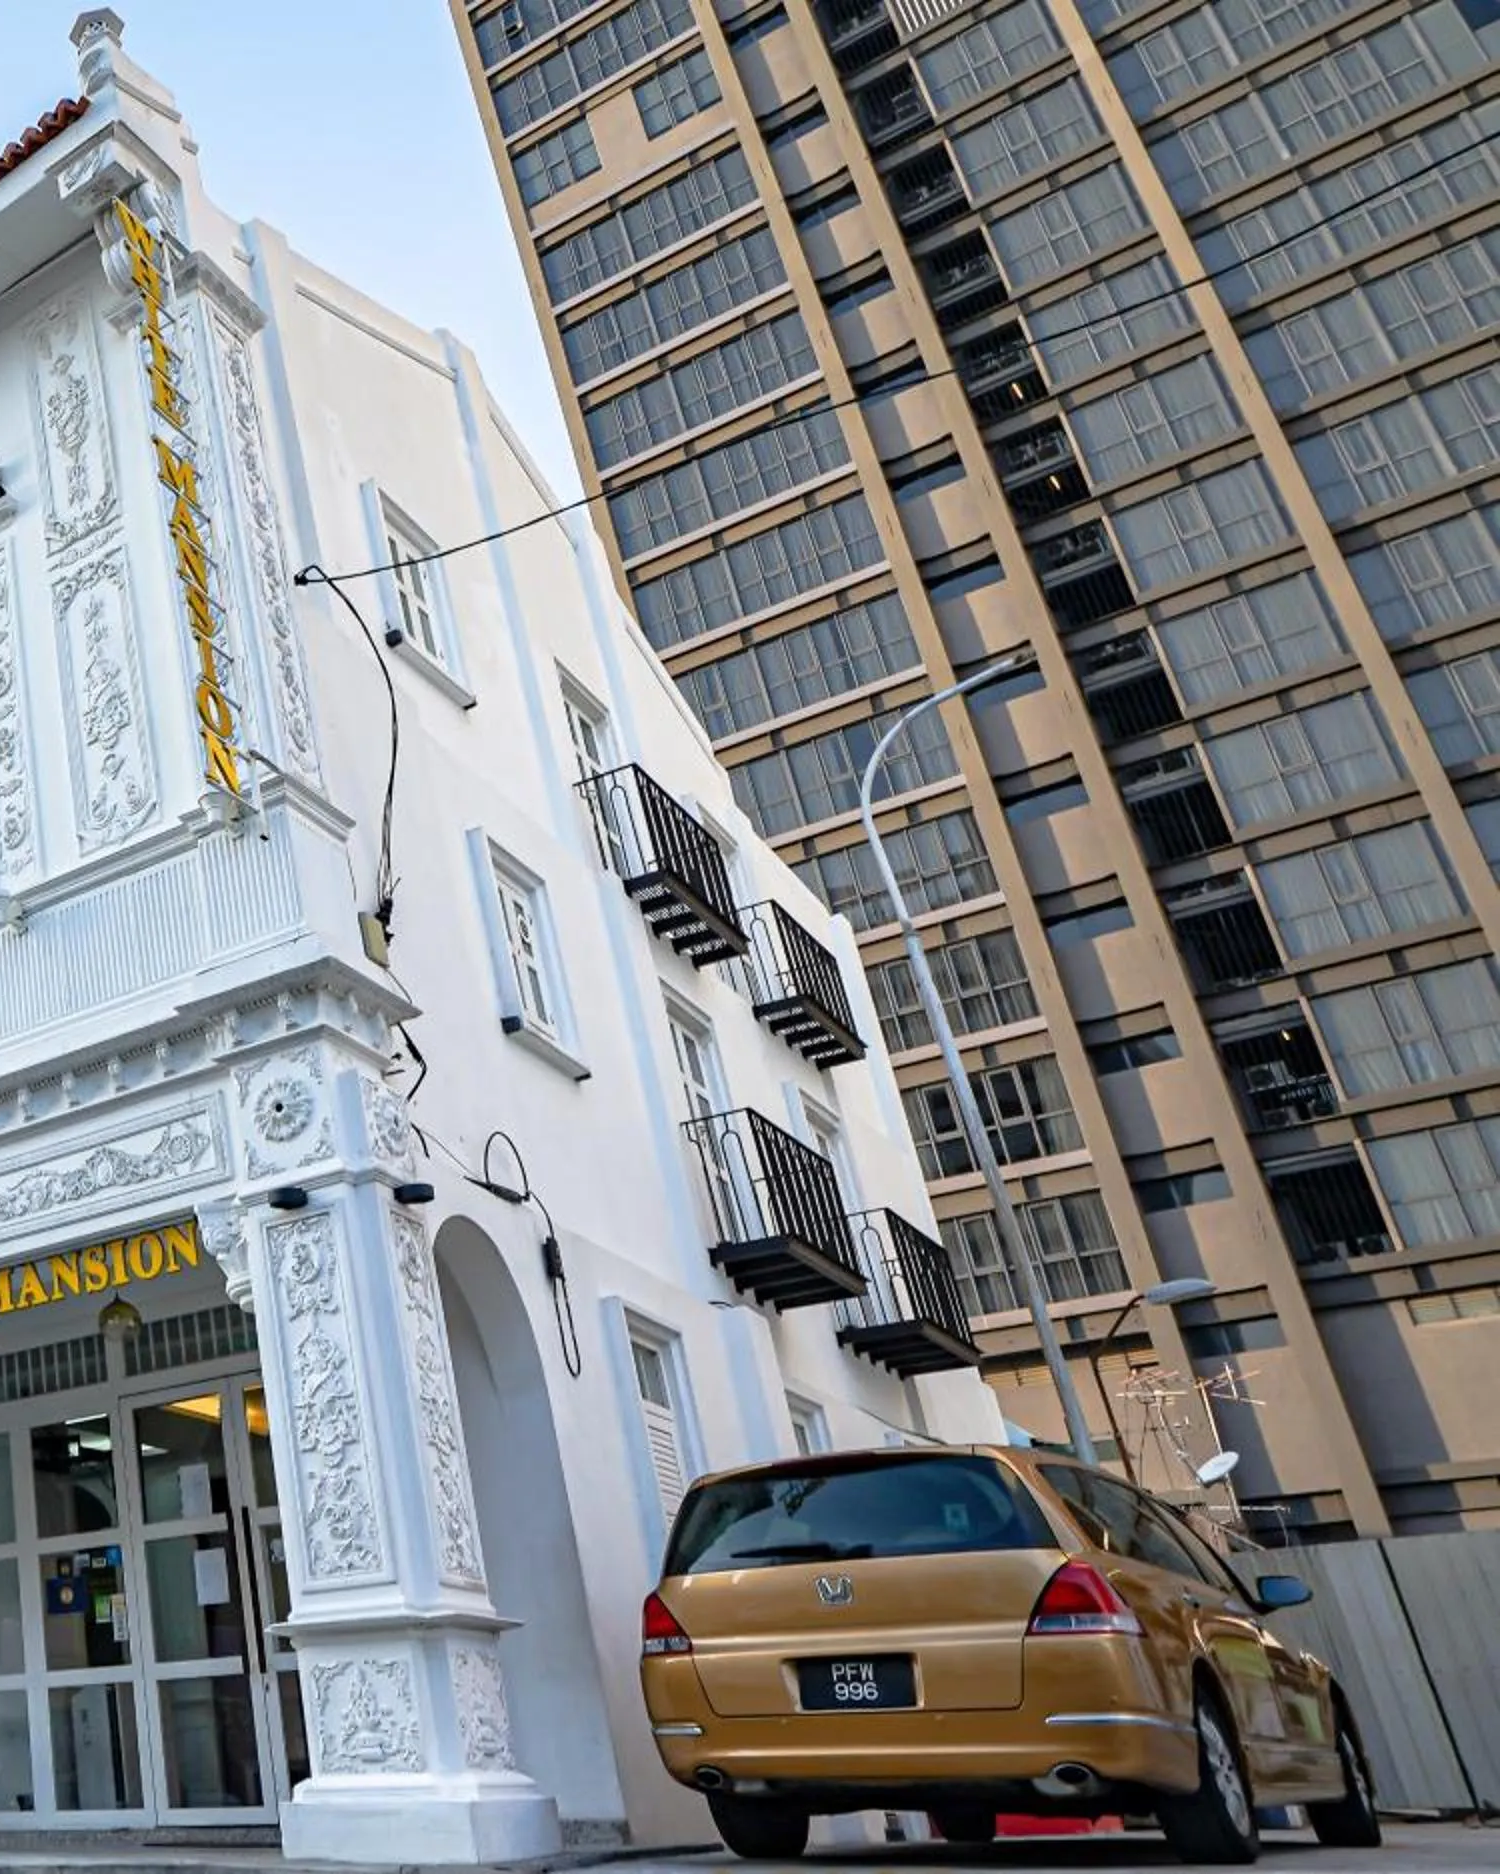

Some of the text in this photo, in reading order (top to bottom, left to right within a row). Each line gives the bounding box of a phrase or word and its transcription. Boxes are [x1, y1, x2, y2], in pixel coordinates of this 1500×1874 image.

[113, 198, 240, 794] WHITE MANSION
[831, 1663, 874, 1681] PFW
[835, 1682, 879, 1701] 996
